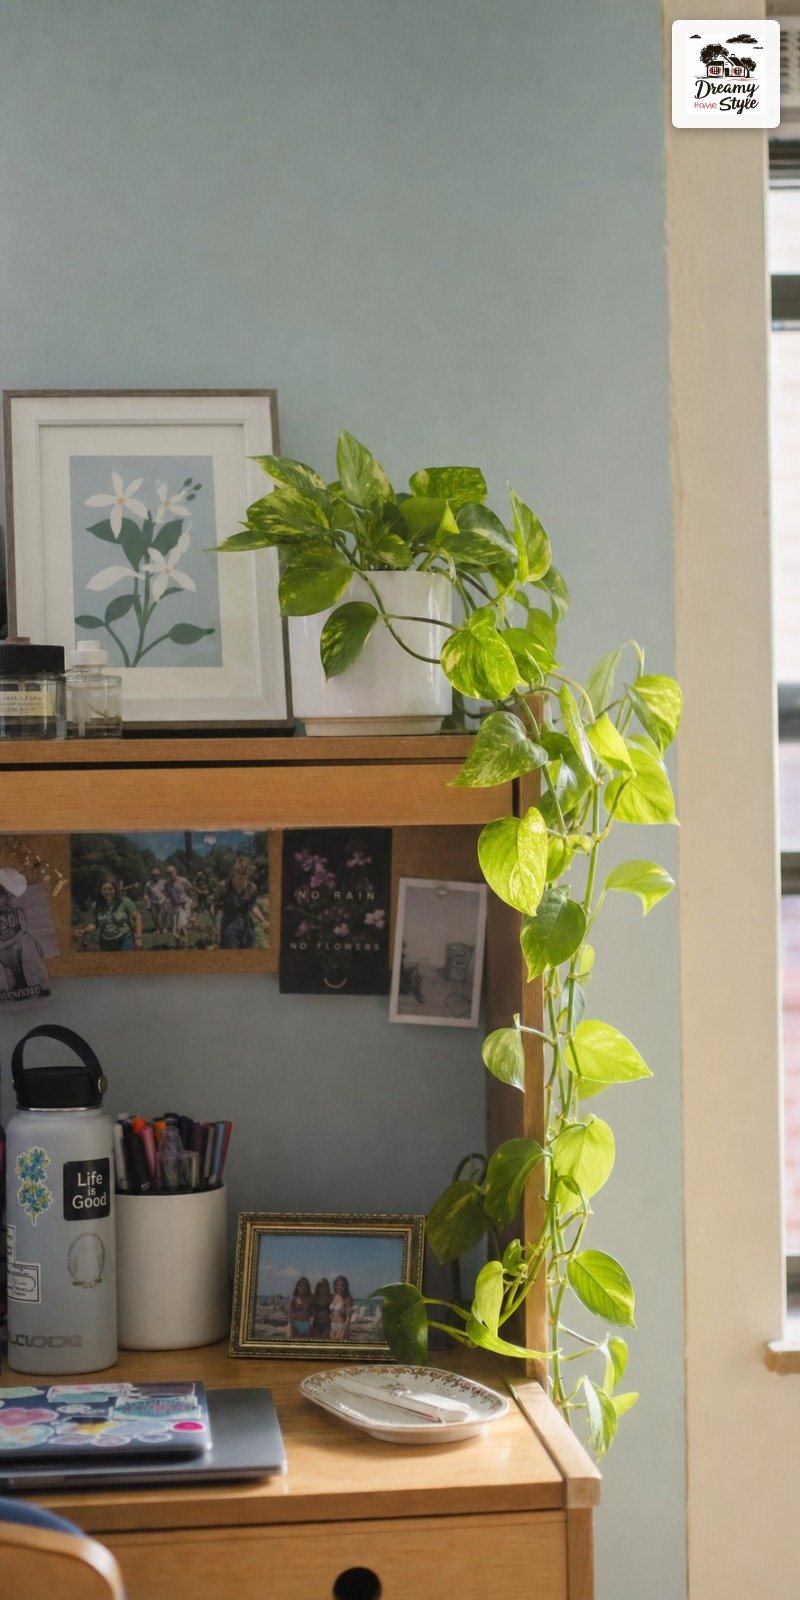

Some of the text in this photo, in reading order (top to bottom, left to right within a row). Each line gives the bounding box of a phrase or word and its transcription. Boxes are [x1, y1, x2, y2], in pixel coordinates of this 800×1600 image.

[298, 890, 376, 901] NO RAIN
[289, 942, 381, 952] NO FLOWERS
[77, 1170, 103, 1187] Life
[87, 1186, 97, 1196] is
[72, 1191, 107, 1210] Good
